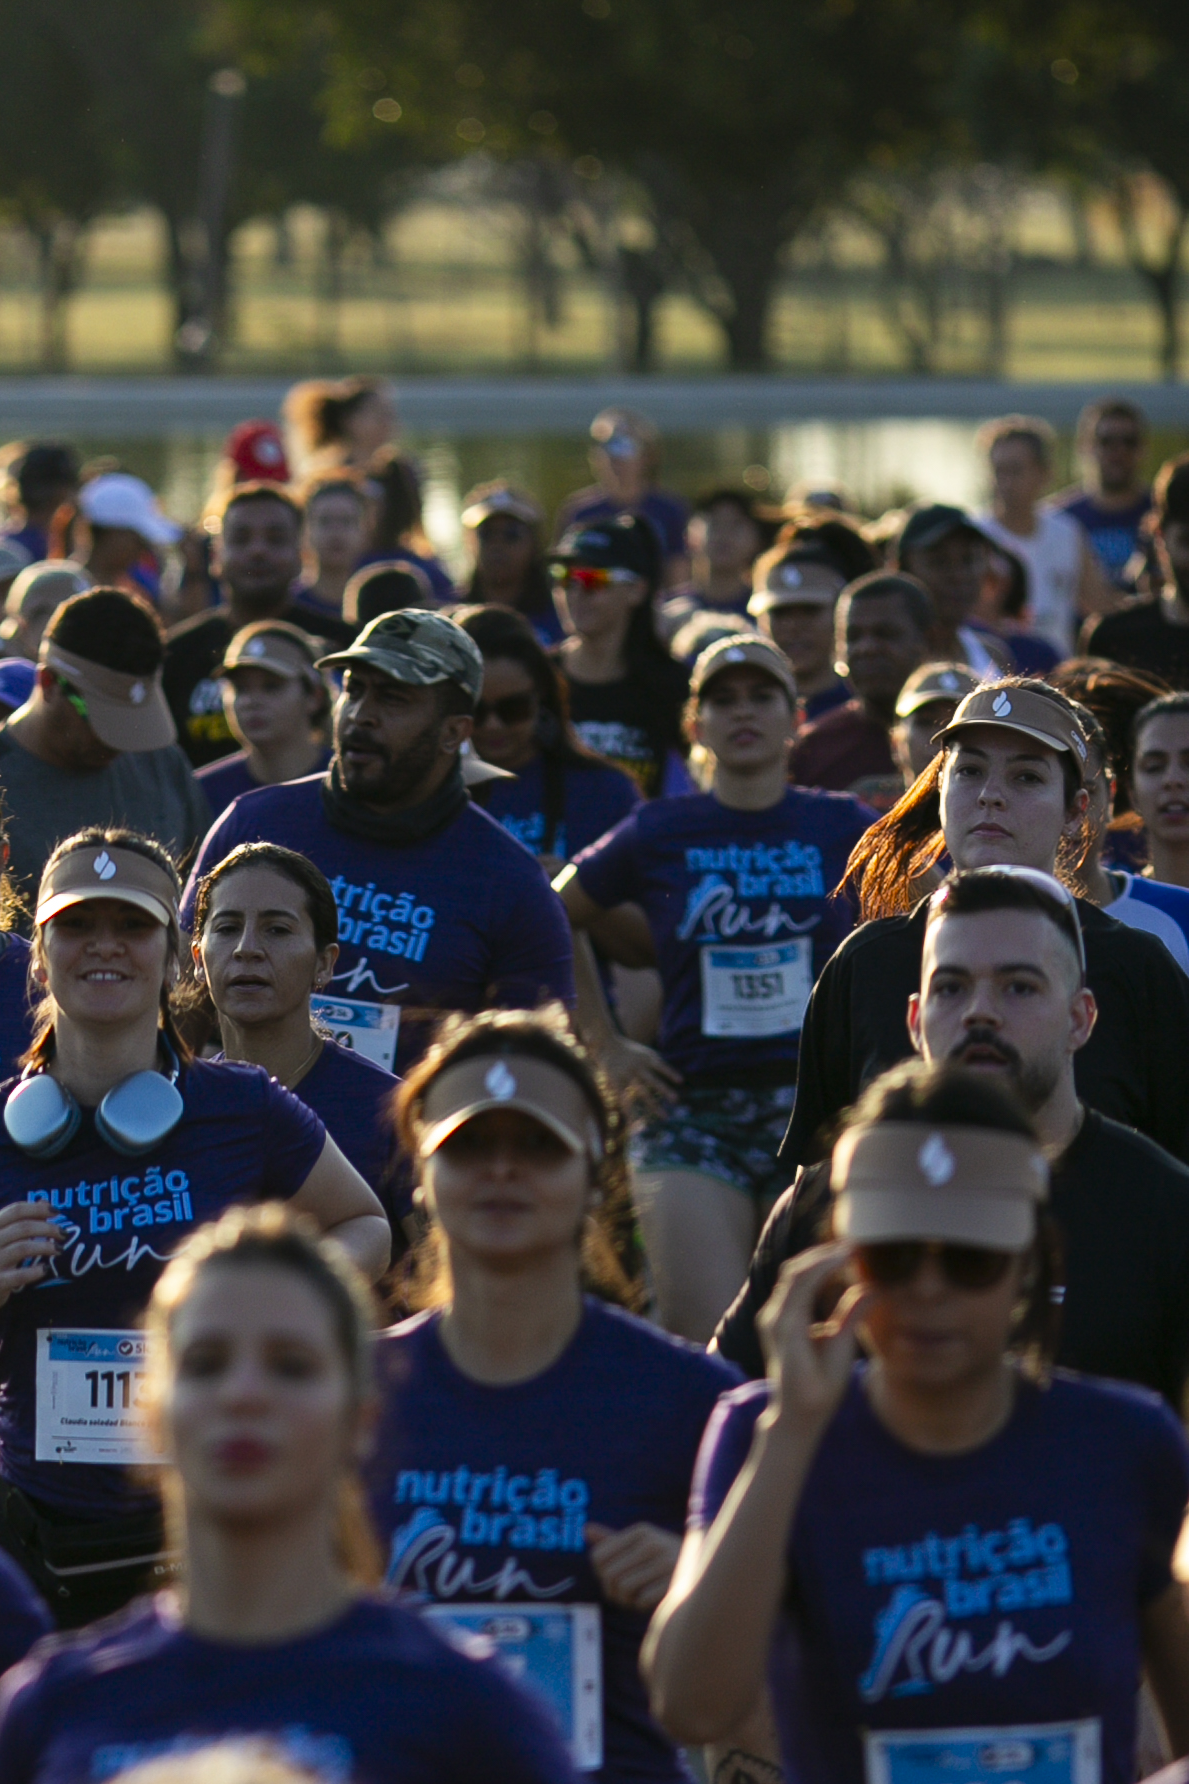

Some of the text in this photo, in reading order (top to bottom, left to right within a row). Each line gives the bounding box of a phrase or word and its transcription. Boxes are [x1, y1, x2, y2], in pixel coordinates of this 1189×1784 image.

[683, 840, 822, 871] nutrição
[328, 875, 436, 929] trição
[736, 869, 825, 898] brasil
[676, 883, 821, 940] Run
[27, 1166, 190, 1209] nutrição
[89, 1192, 194, 1234] brasil
[60, 1417, 87, 1426] Claudia
[395, 1464, 591, 1513] nutrição
[460, 1505, 587, 1553] brasil
[862, 1517, 1070, 1586] nutrição
[385, 1524, 577, 1600] Run
[944, 1564, 1075, 1620] brasil
[859, 1598, 1073, 1703] Run
